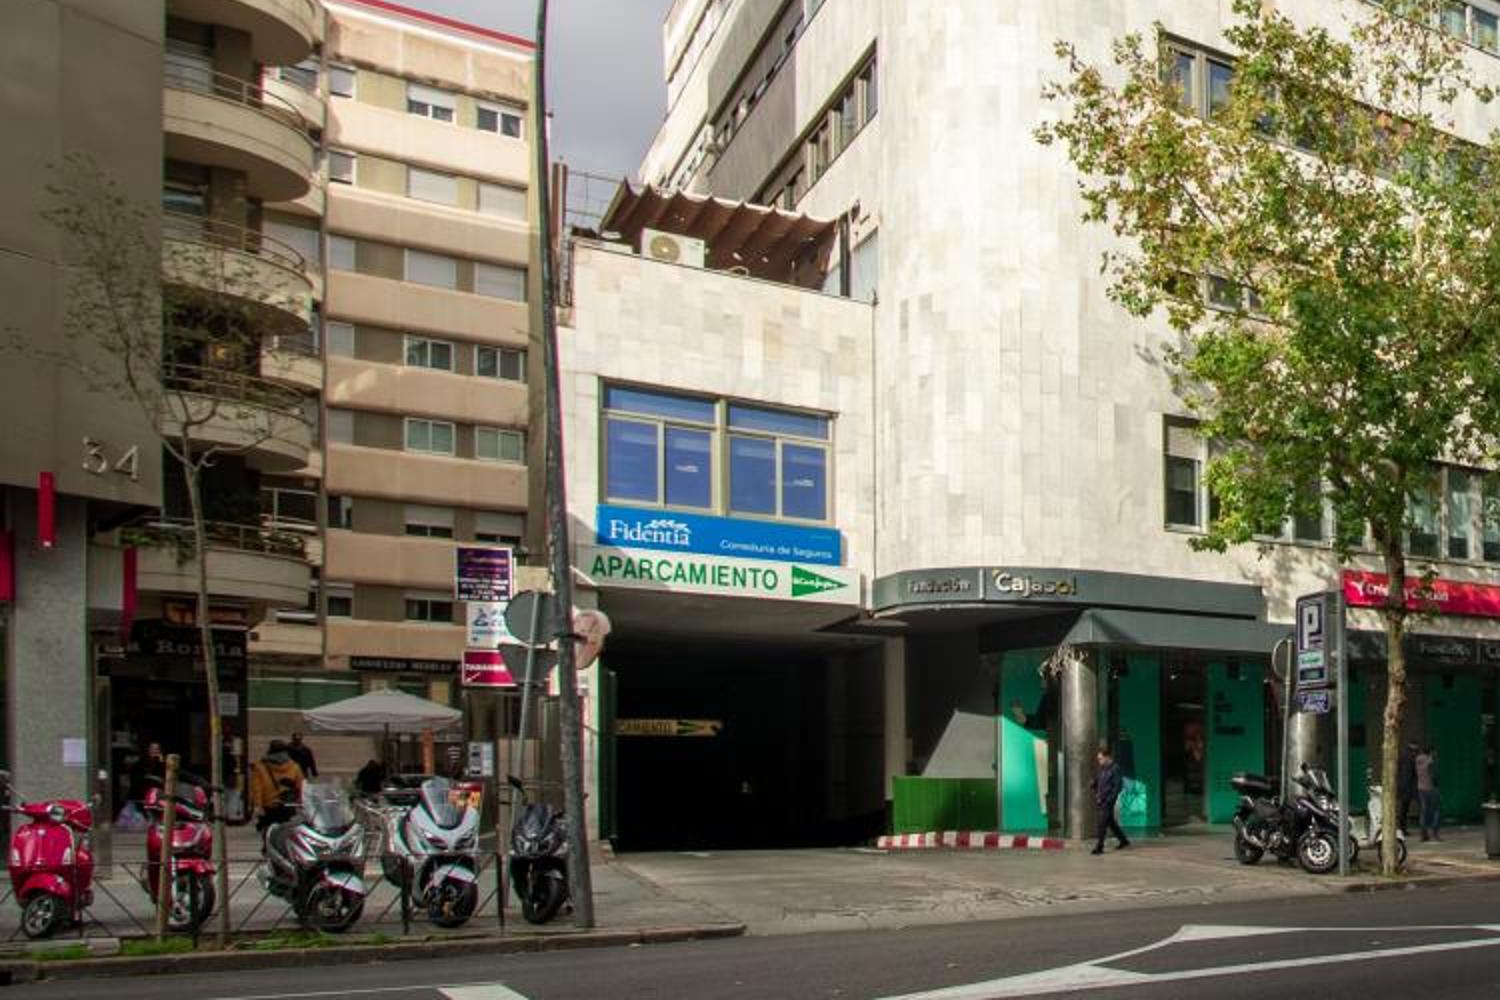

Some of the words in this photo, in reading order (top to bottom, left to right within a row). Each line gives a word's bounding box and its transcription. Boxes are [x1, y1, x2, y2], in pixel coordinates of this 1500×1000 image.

[81, 435, 139, 481] 34
[609, 519, 690, 546] Fidentia
[777, 543, 790, 555] de
[792, 546, 833, 561] Seguros
[590, 554, 779, 591] APARCAMIENTO
[993, 572, 1078, 598] Cajasol
[1303, 605, 1319, 650] P
